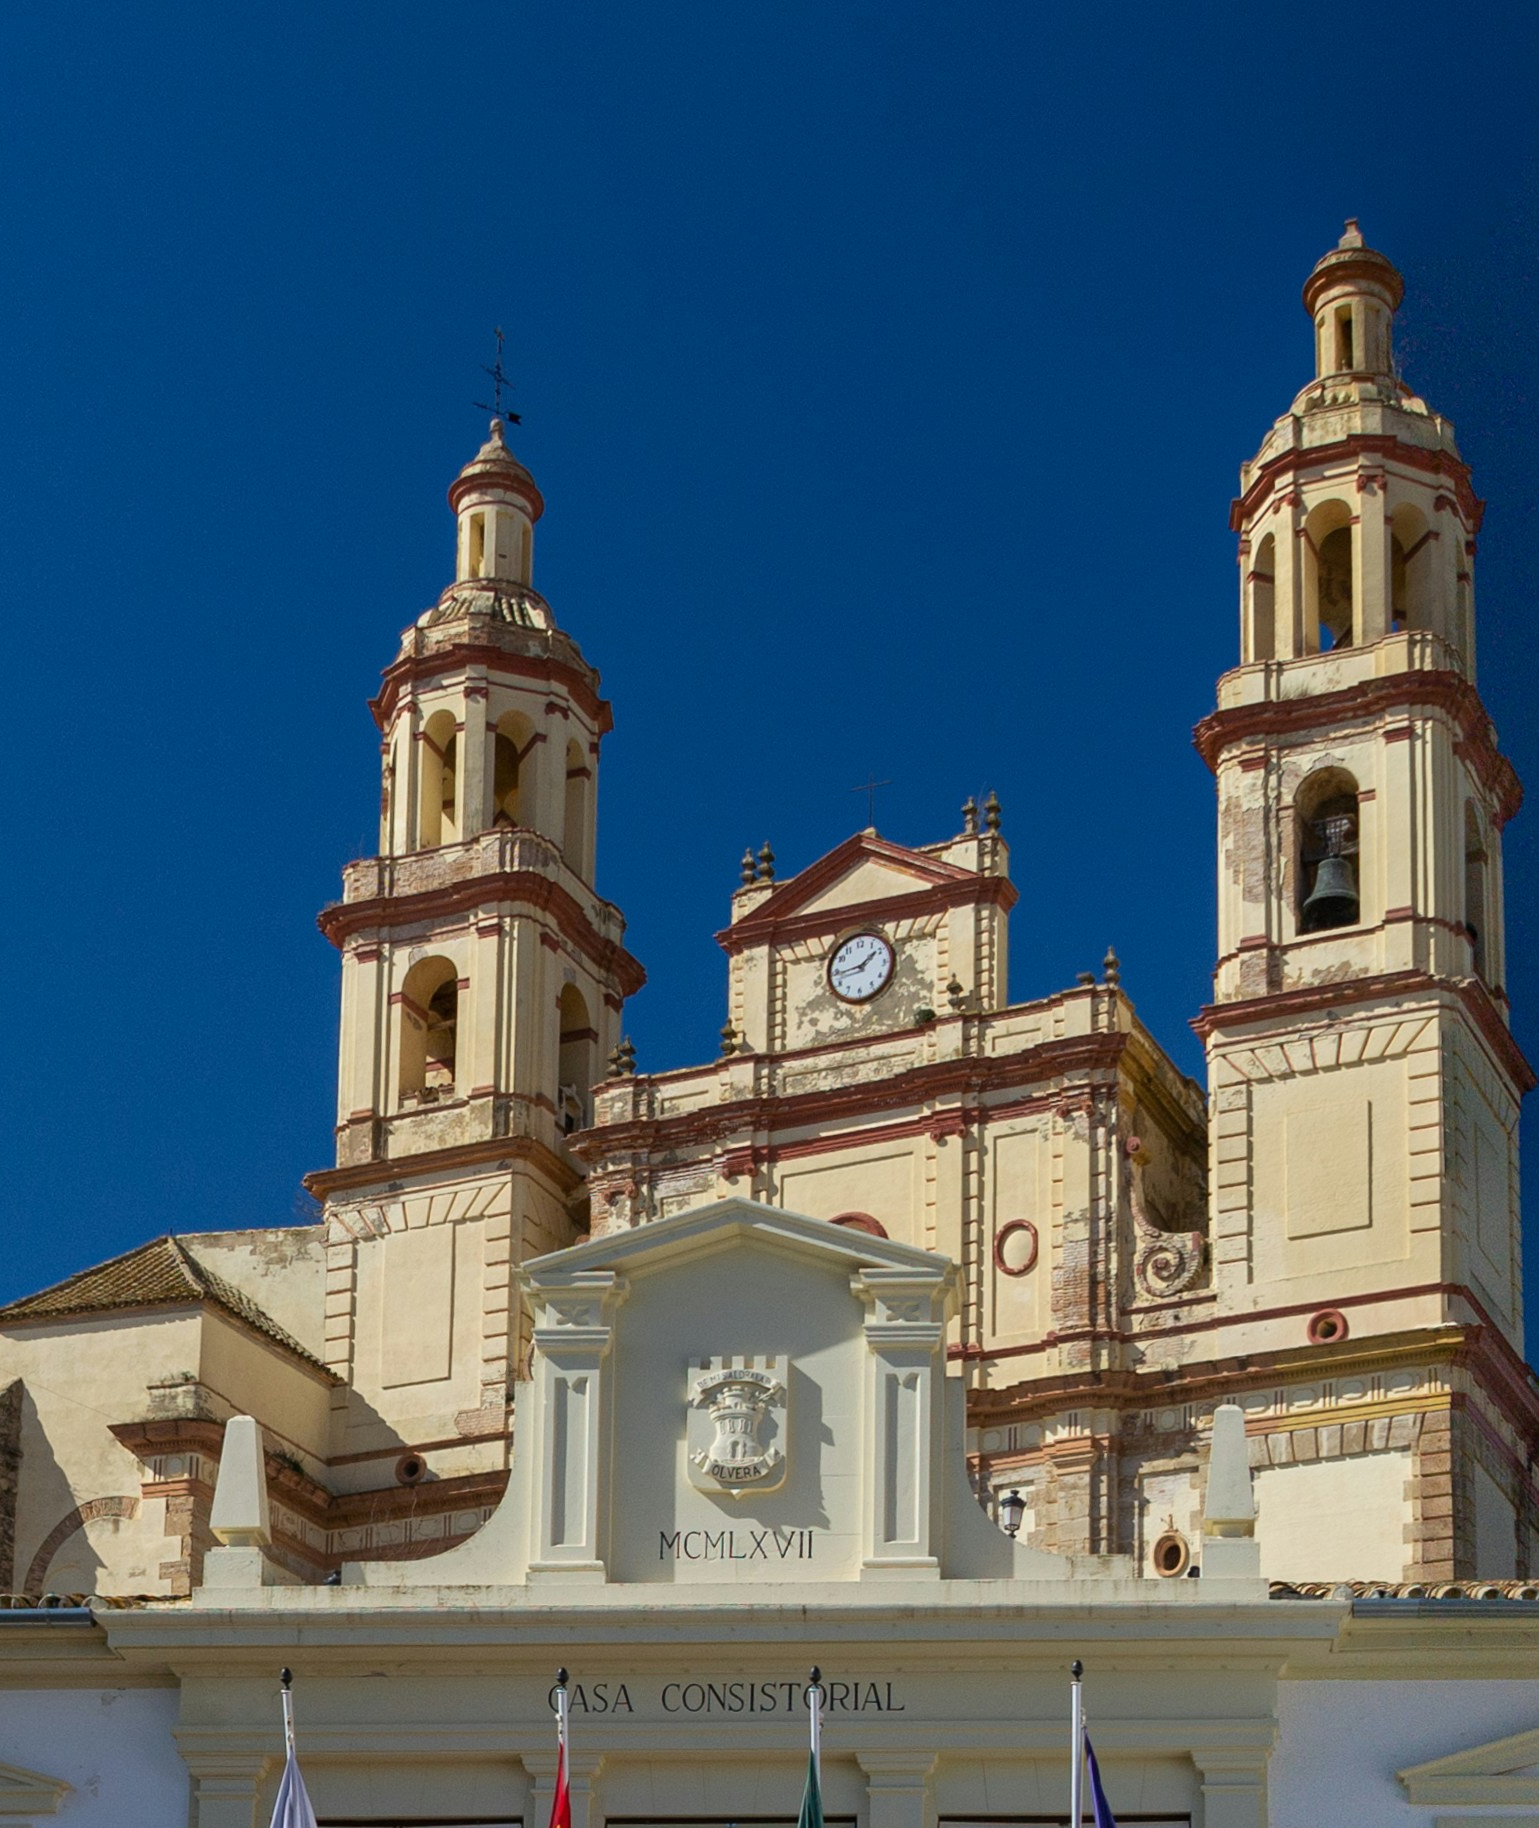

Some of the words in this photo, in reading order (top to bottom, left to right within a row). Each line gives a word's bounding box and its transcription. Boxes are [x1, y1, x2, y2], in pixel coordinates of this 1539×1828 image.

[856, 940, 864, 948] 12
[846, 946, 852, 955] 11
[838, 954, 846, 963] 10
[711, 1465, 762, 1480] OLVERA
[659, 1530, 814, 1560] MCMLXVII
[548, 1683, 634, 1713] CASA
[662, 1682, 906, 1713] CONSISTORIAL
